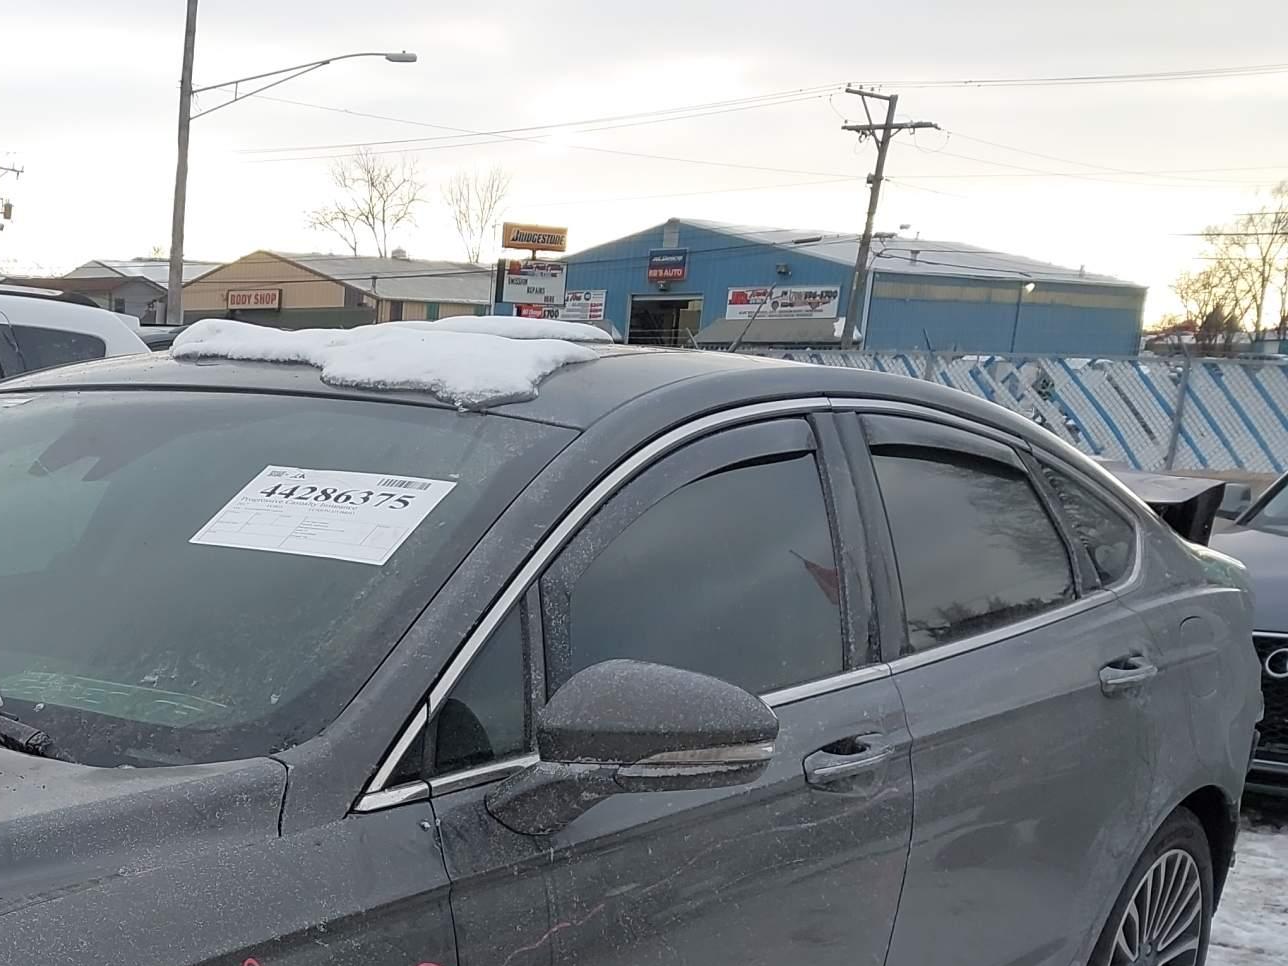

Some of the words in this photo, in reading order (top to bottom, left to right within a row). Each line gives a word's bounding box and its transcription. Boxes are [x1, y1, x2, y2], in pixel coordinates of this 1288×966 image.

[512, 228, 566, 245] BRIDGESTONE
[664, 268, 683, 277] AUTO
[230, 294, 252, 305] BODY
[253, 292, 277, 305] SHOP
[259, 483, 416, 510] 44286375
